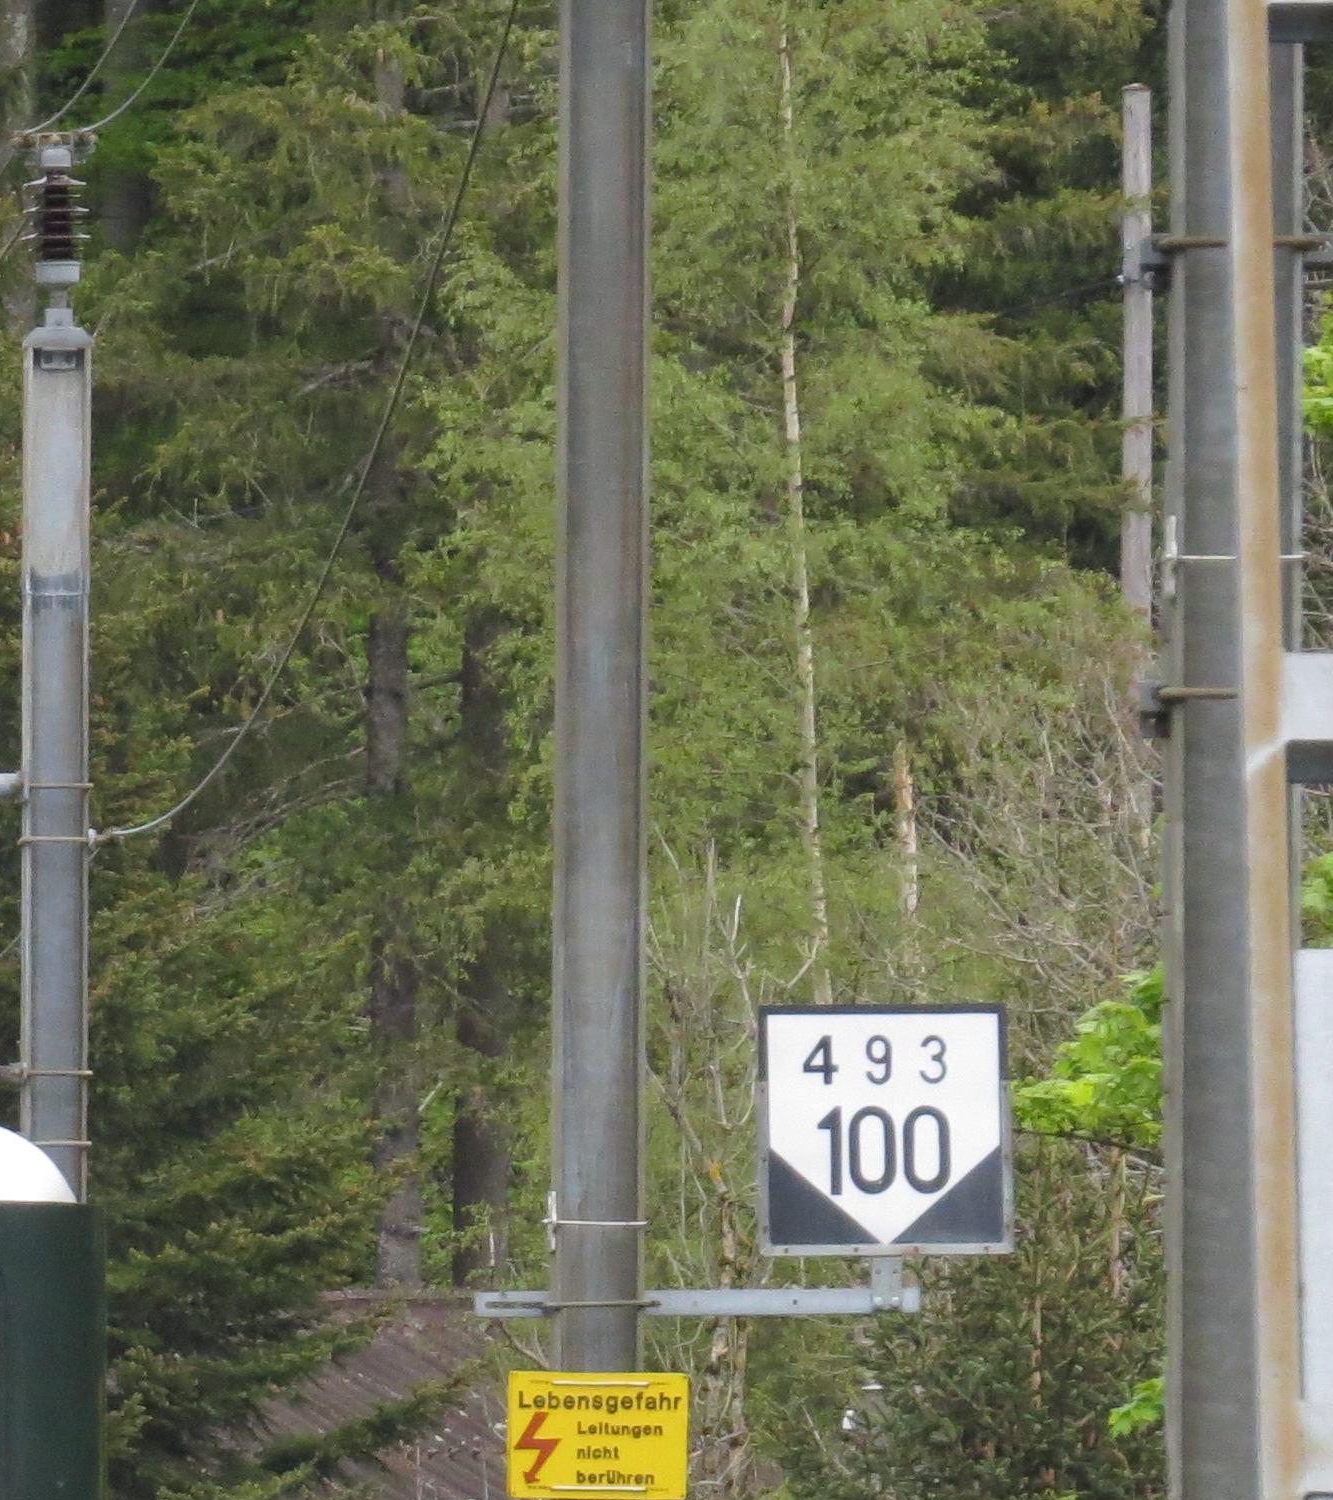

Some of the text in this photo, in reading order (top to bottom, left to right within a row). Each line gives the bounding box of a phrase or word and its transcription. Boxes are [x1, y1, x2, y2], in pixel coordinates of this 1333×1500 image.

[817, 1104, 953, 1198] 100
[518, 1390, 682, 1414] Lebensgefahr
[576, 1421, 664, 1439] Leitungen
[576, 1446, 620, 1460] nicht
[576, 1469, 656, 1485] berühren
